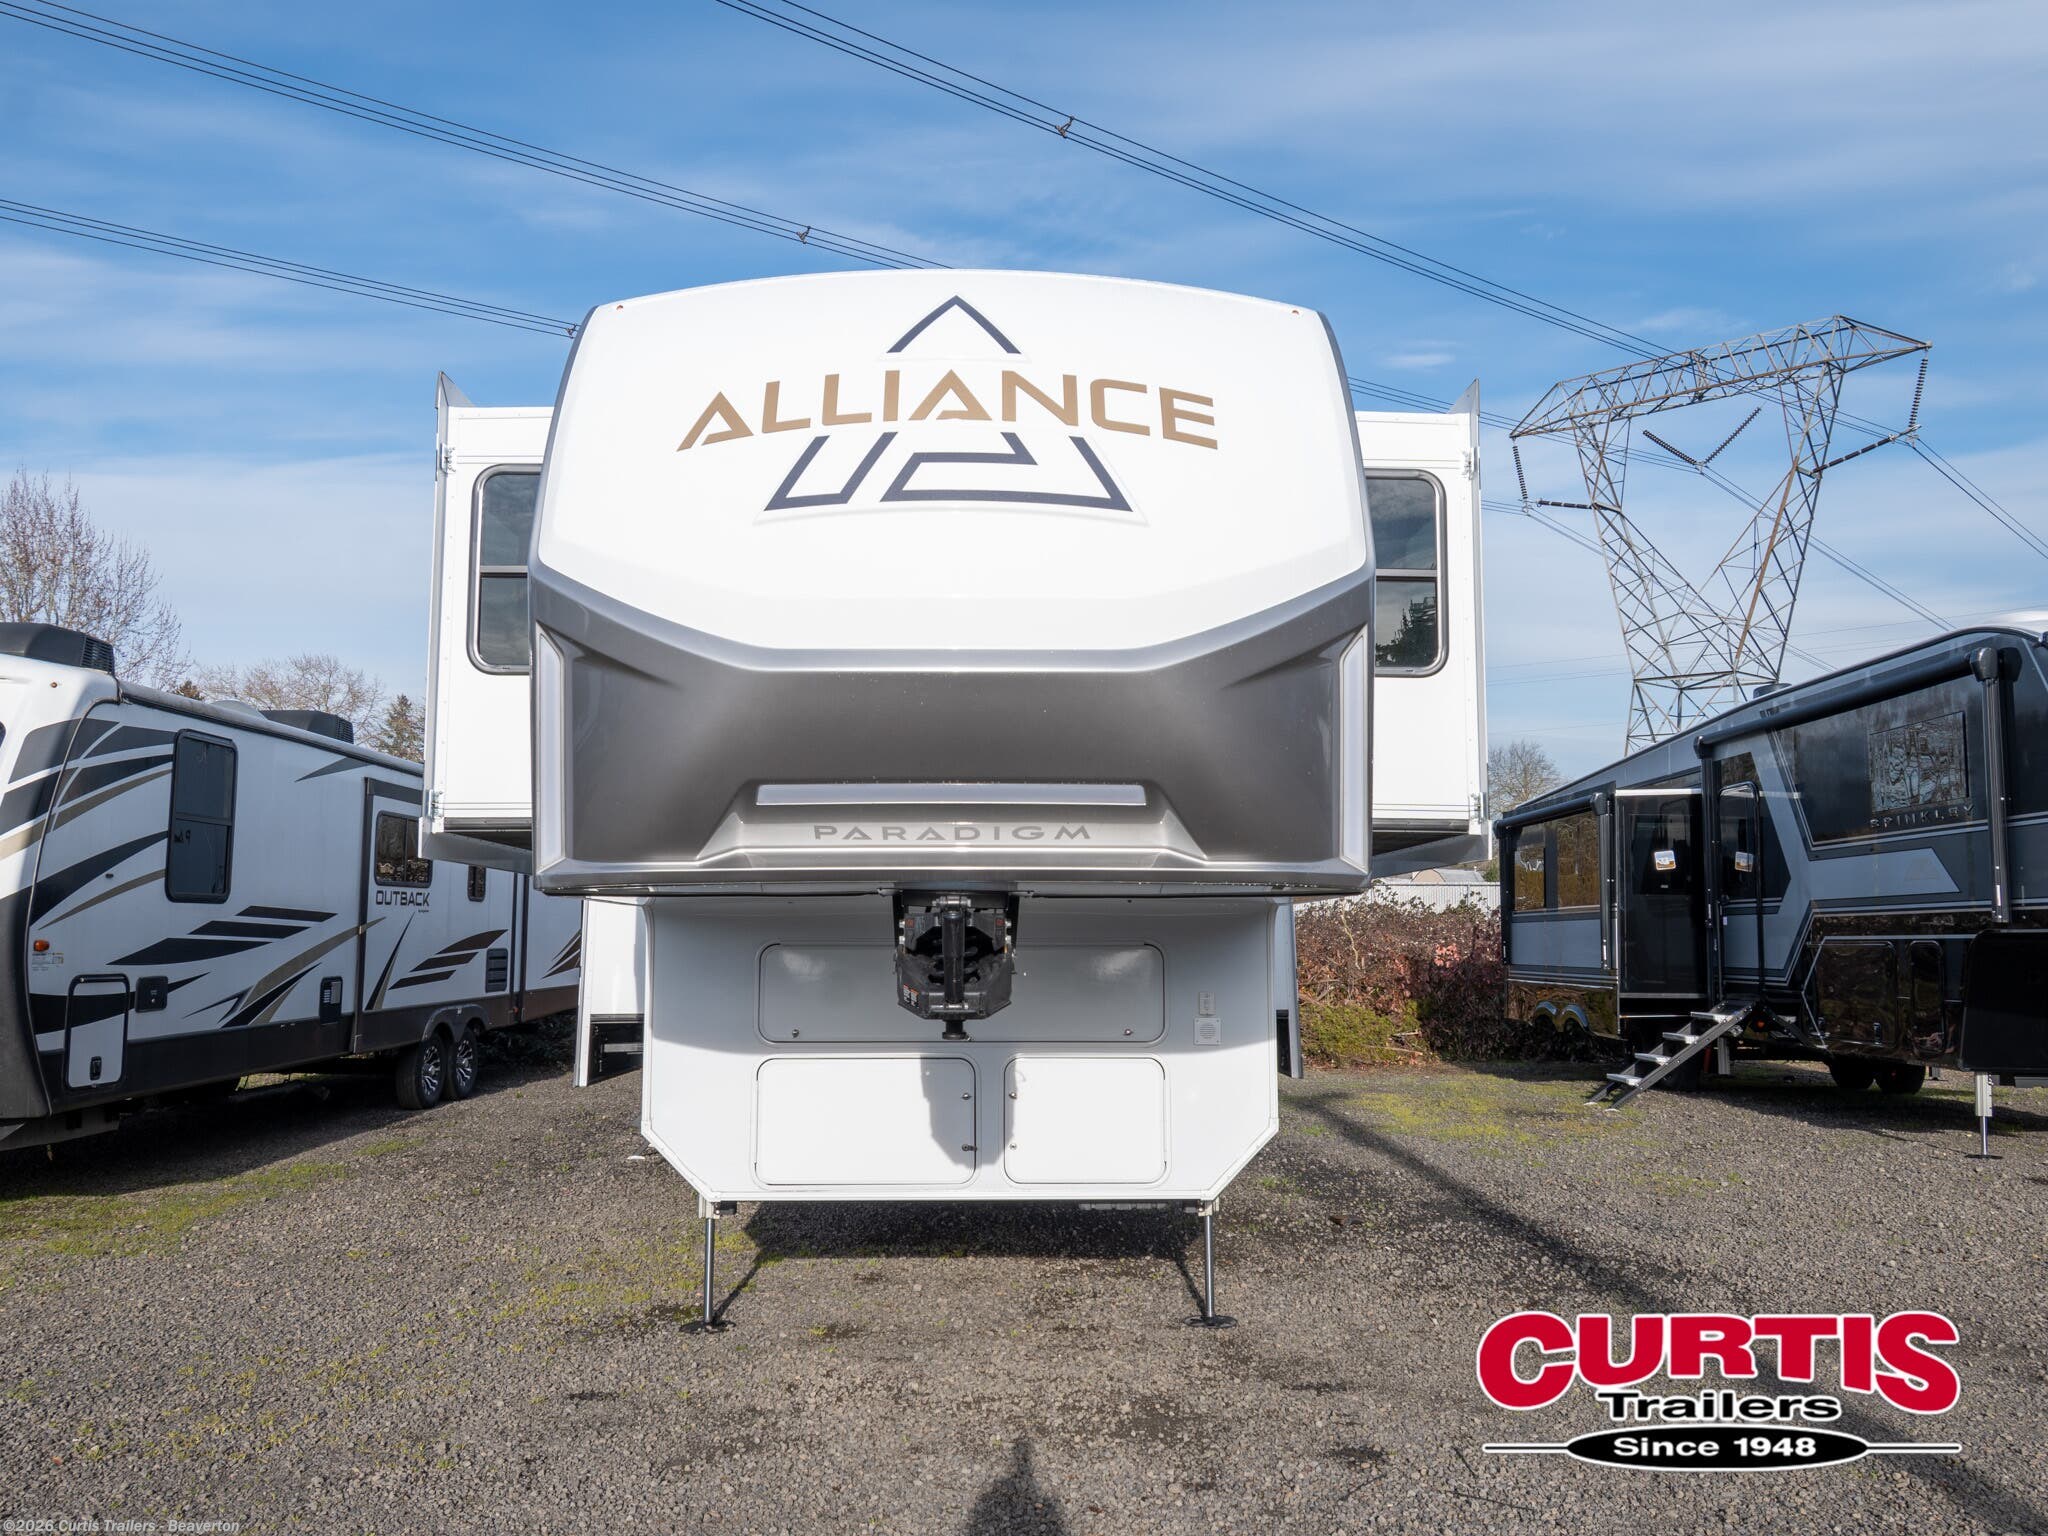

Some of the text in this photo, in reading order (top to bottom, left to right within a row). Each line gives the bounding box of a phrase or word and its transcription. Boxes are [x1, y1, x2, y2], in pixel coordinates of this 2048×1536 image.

[676, 369, 1218, 452] ALLIANCE
[813, 825, 1091, 841] PARADIGM
[375, 890, 430, 907] OUTBACK
